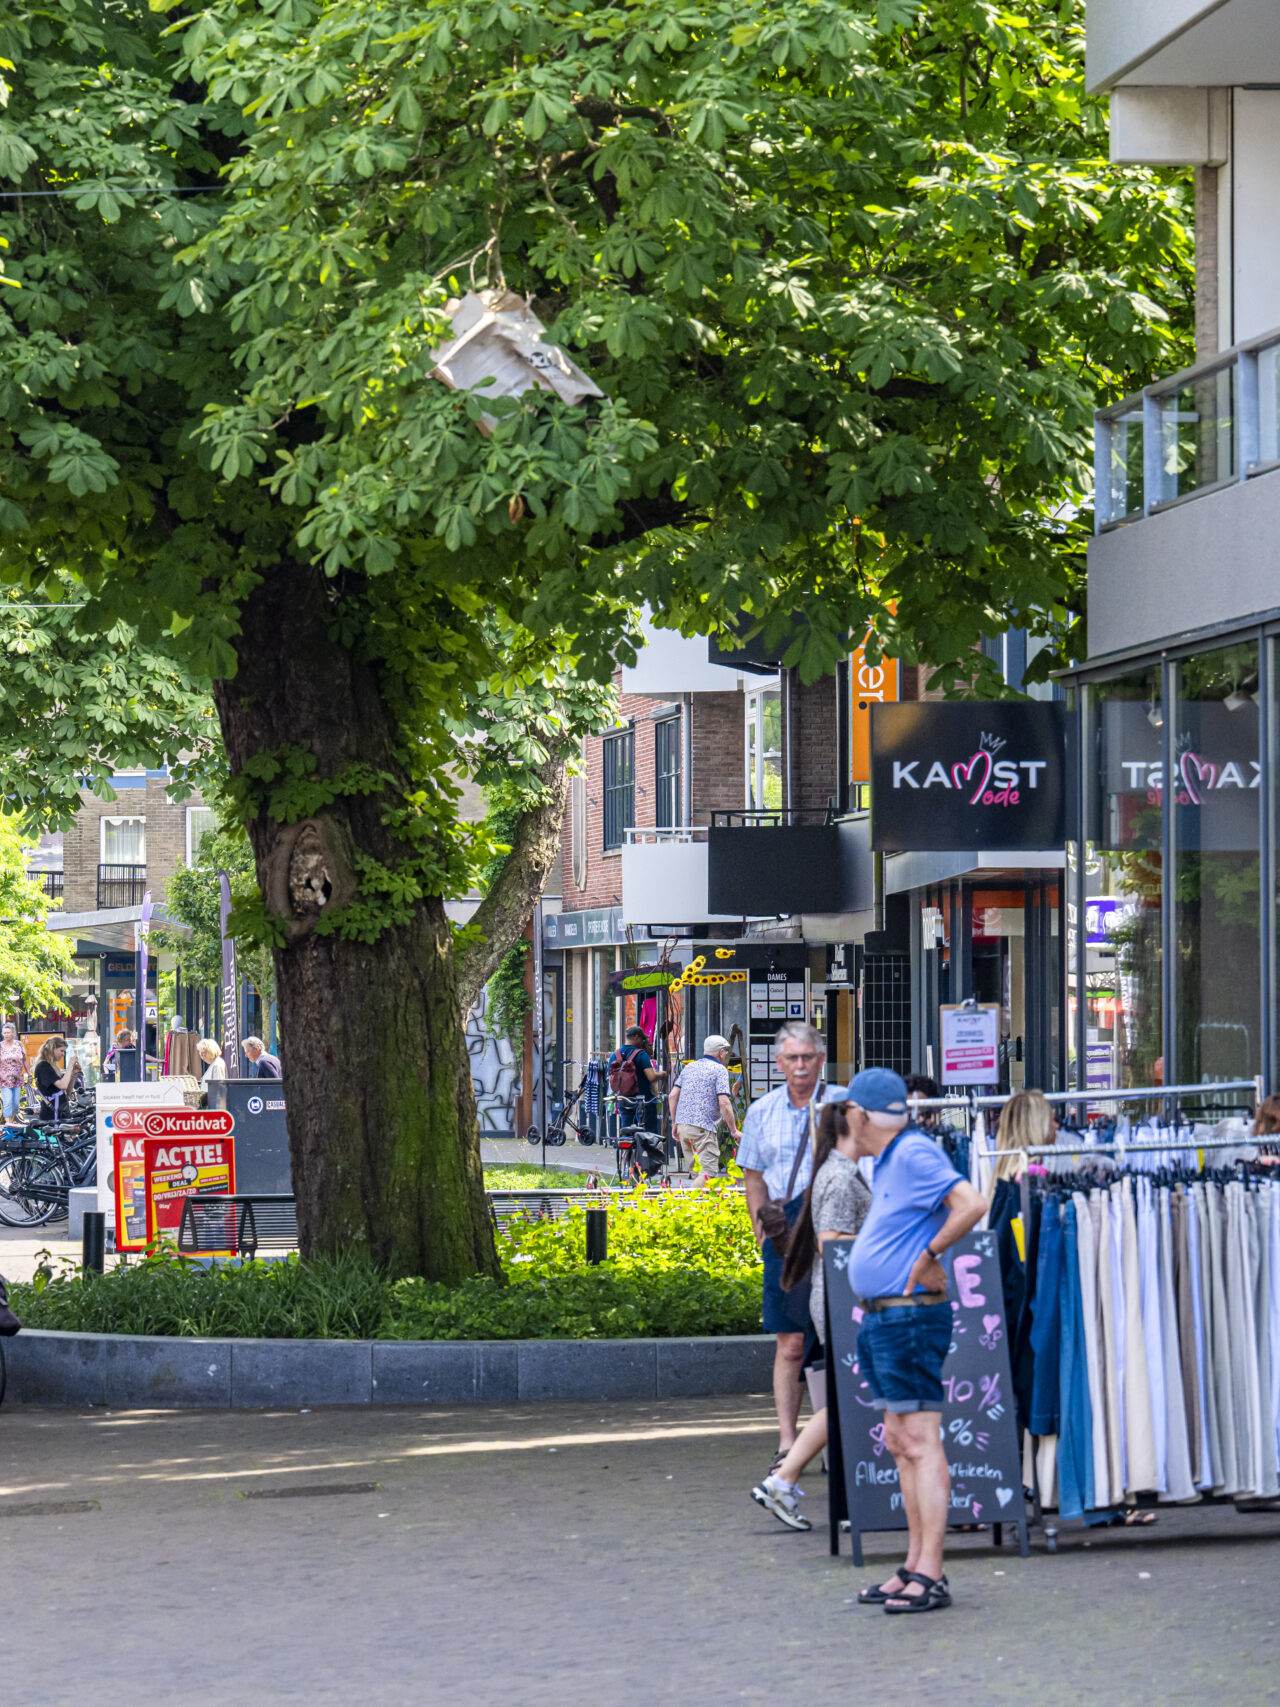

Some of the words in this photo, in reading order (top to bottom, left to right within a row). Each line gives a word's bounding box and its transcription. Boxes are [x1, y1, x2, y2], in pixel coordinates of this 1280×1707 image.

[893, 752, 1047, 804] KAMST
[767, 973, 787, 981] DAMES
[166, 1116, 227, 1131] Kruidvat
[155, 1144, 223, 1167] ACTIE!
[153, 1172, 182, 1183] WEEKEND
[172, 1180, 188, 1188] DEAL
